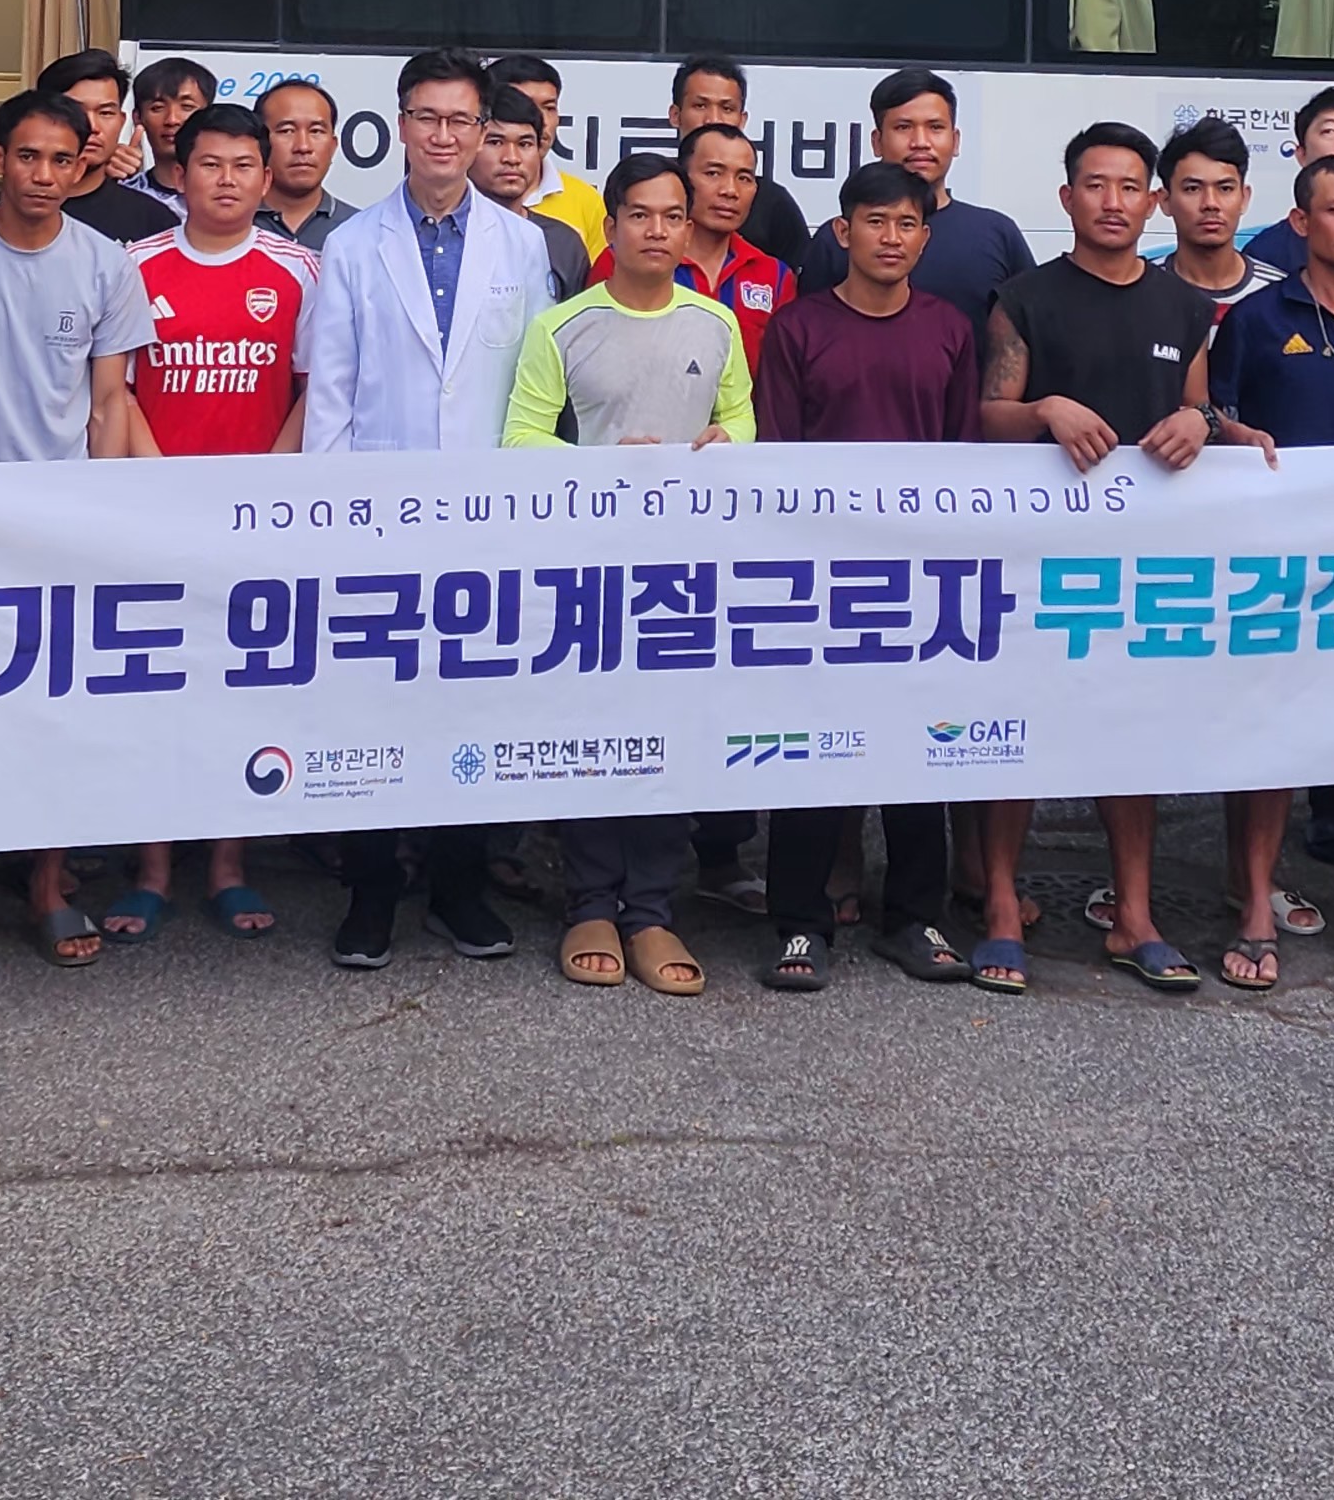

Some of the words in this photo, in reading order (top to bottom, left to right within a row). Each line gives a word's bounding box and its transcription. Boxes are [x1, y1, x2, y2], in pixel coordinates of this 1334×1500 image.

[148, 335, 277, 367] Emirates
[163, 369, 191, 393] FLY
[194, 368, 259, 393] BETTER
[225, 558, 1017, 690] 외국인계절근로자
[817, 731, 866, 750] 경기도
[969, 719, 1026, 742] GAFI
[305, 745, 403, 773] 질병관리청
[493, 735, 666, 769] 한국한센복지협회
[494, 771, 528, 781] Korean
[532, 769, 568, 779] Hansen
[610, 765, 665, 777] Association
